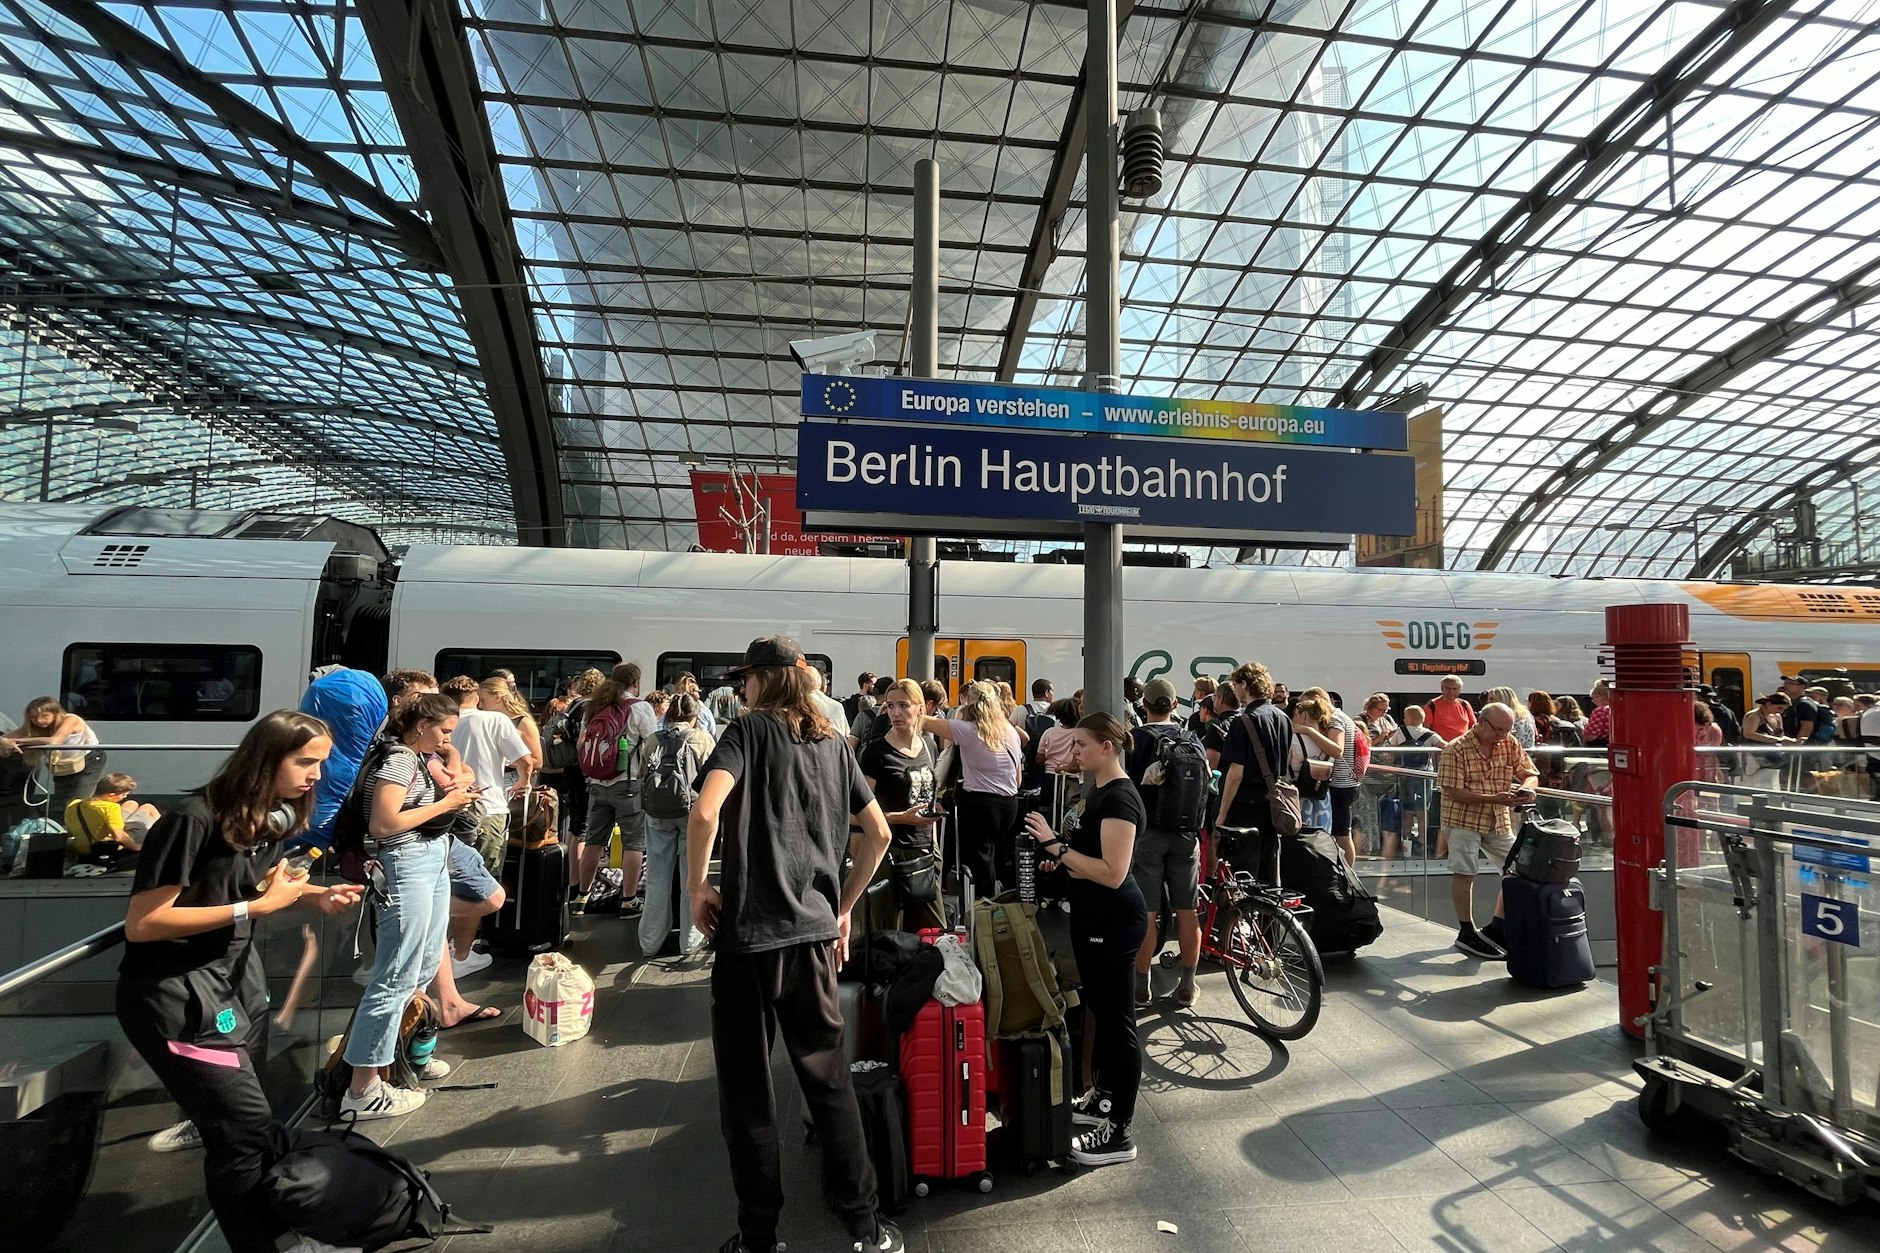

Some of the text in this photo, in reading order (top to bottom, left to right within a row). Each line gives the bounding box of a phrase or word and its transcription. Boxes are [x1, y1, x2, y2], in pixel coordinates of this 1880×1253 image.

[902, 390, 969, 415] Europa
[976, 397, 1069, 419] verstehen
[1104, 406, 1325, 436] www.erlebnis-europa.eu
[827, 440, 1287, 503] Berlin Hauptbahnhof
[732, 530, 777, 541] Jead
[781, 532, 797, 543] da,
[800, 533, 819, 542] der
[821, 534, 848, 543] beim
[785, 547, 812, 555] neue
[1408, 621, 1471, 650] ODEG
[1816, 902, 1844, 936] 5
